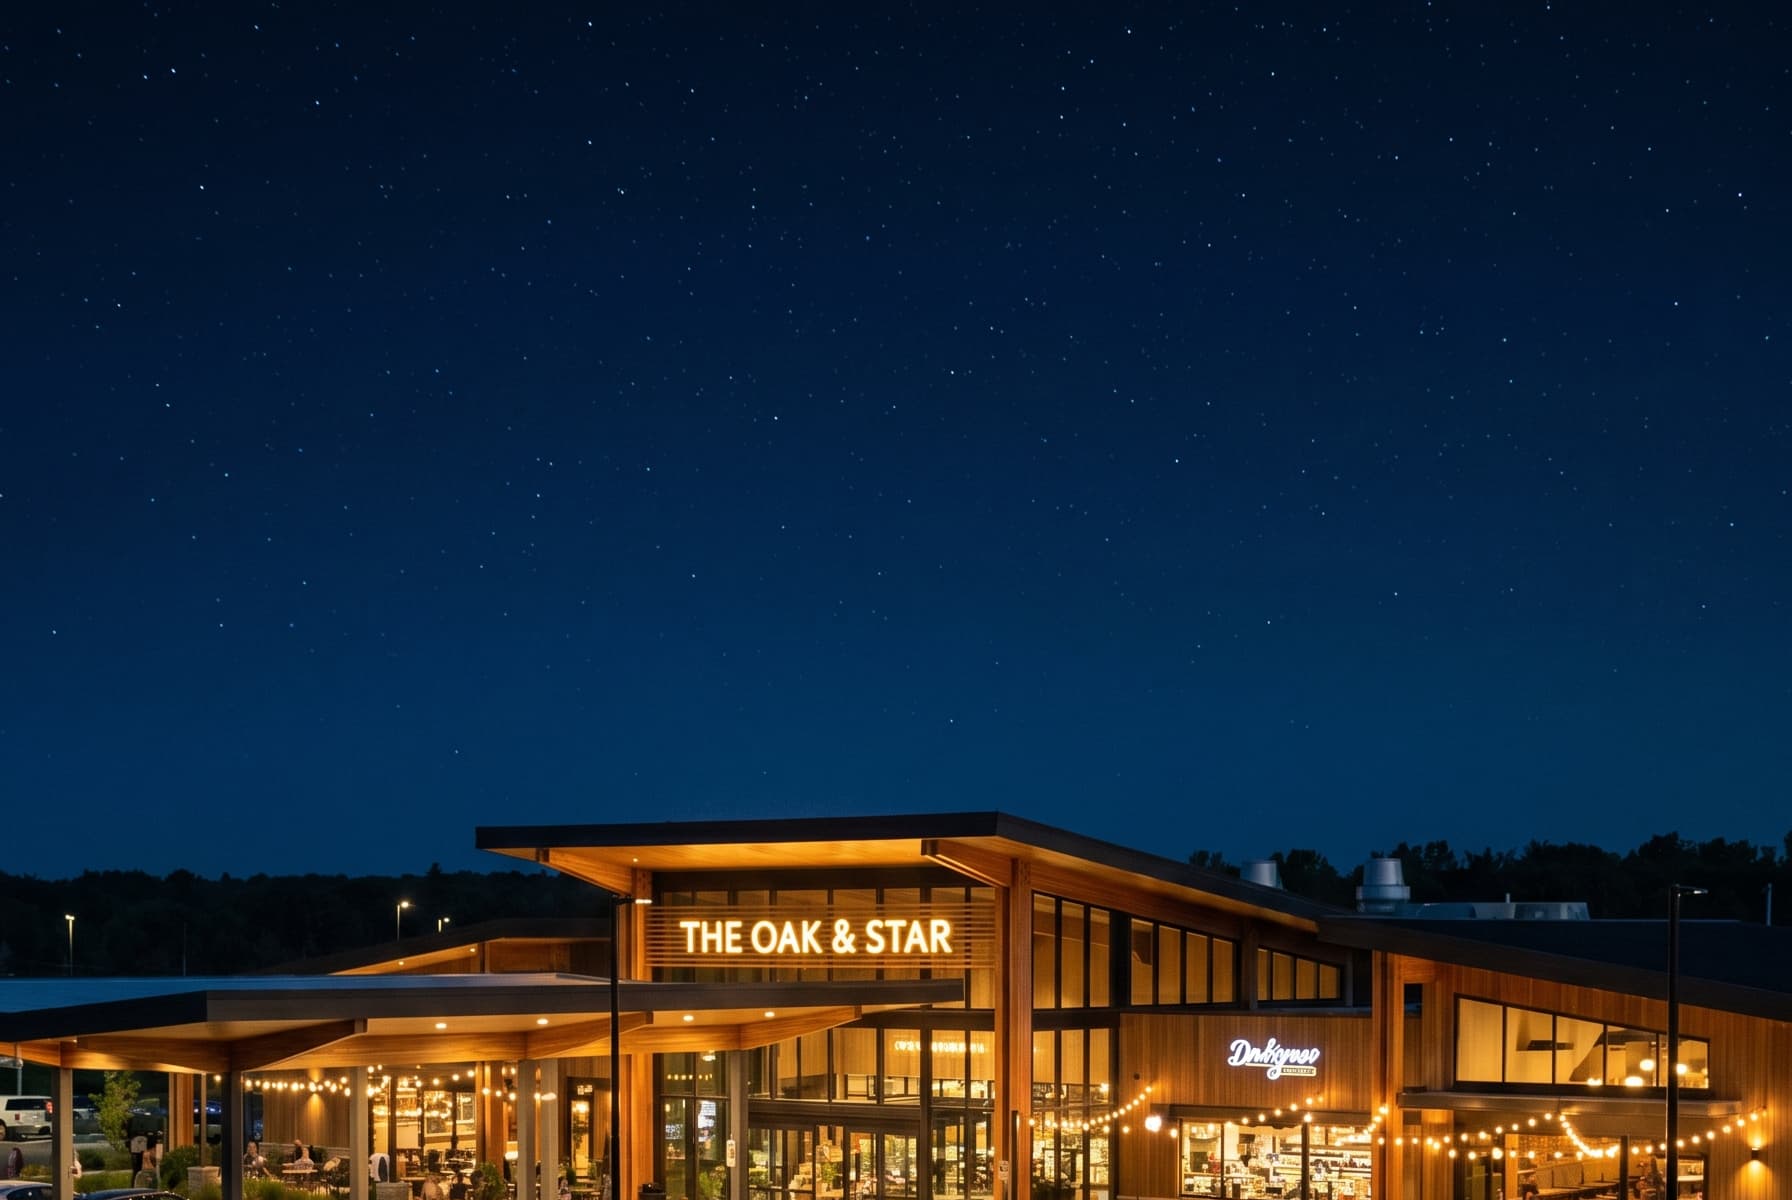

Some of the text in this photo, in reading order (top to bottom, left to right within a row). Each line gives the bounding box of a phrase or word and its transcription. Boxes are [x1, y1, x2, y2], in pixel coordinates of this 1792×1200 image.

[679, 918, 953, 954] THE OAK & STAR
